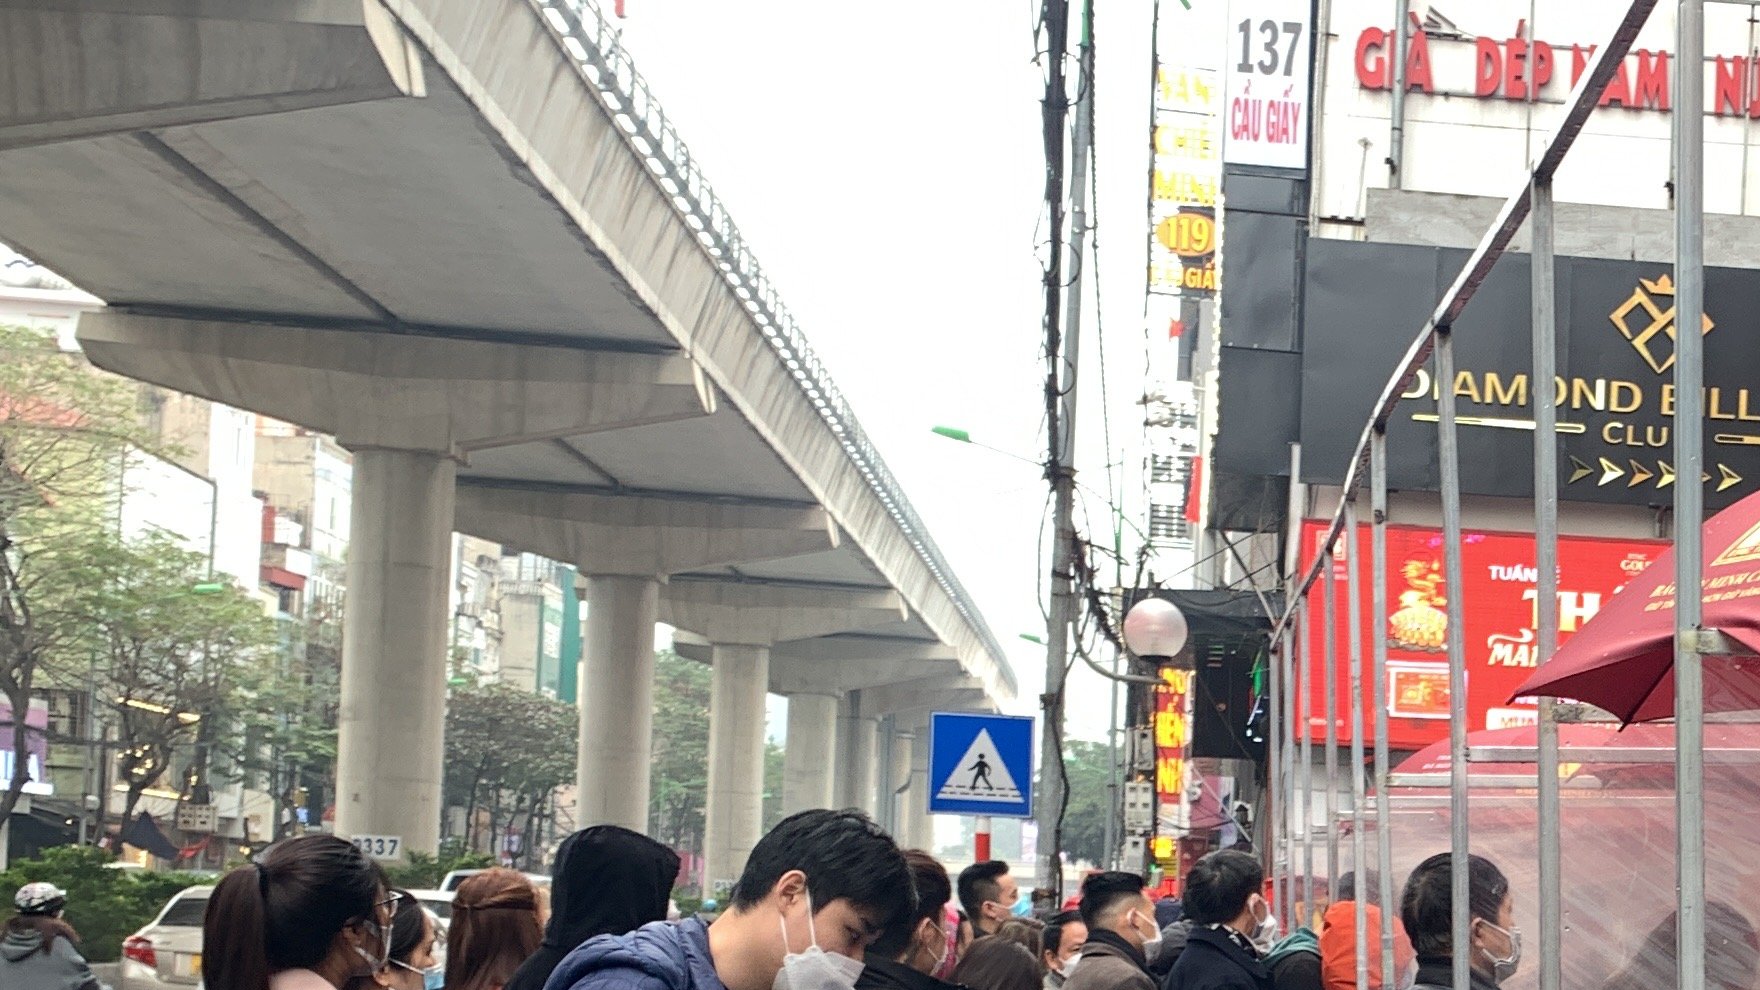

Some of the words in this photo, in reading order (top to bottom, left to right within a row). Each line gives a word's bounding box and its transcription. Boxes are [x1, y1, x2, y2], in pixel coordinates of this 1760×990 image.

[1236, 18, 1303, 77] 137
[1475, 19, 1554, 100] DÉP
[1265, 84, 1302, 145] GIẤY
[1165, 216, 1210, 253] 119
[1401, 369, 1643, 415] DAMND
[1602, 421, 1669, 448] CLU
